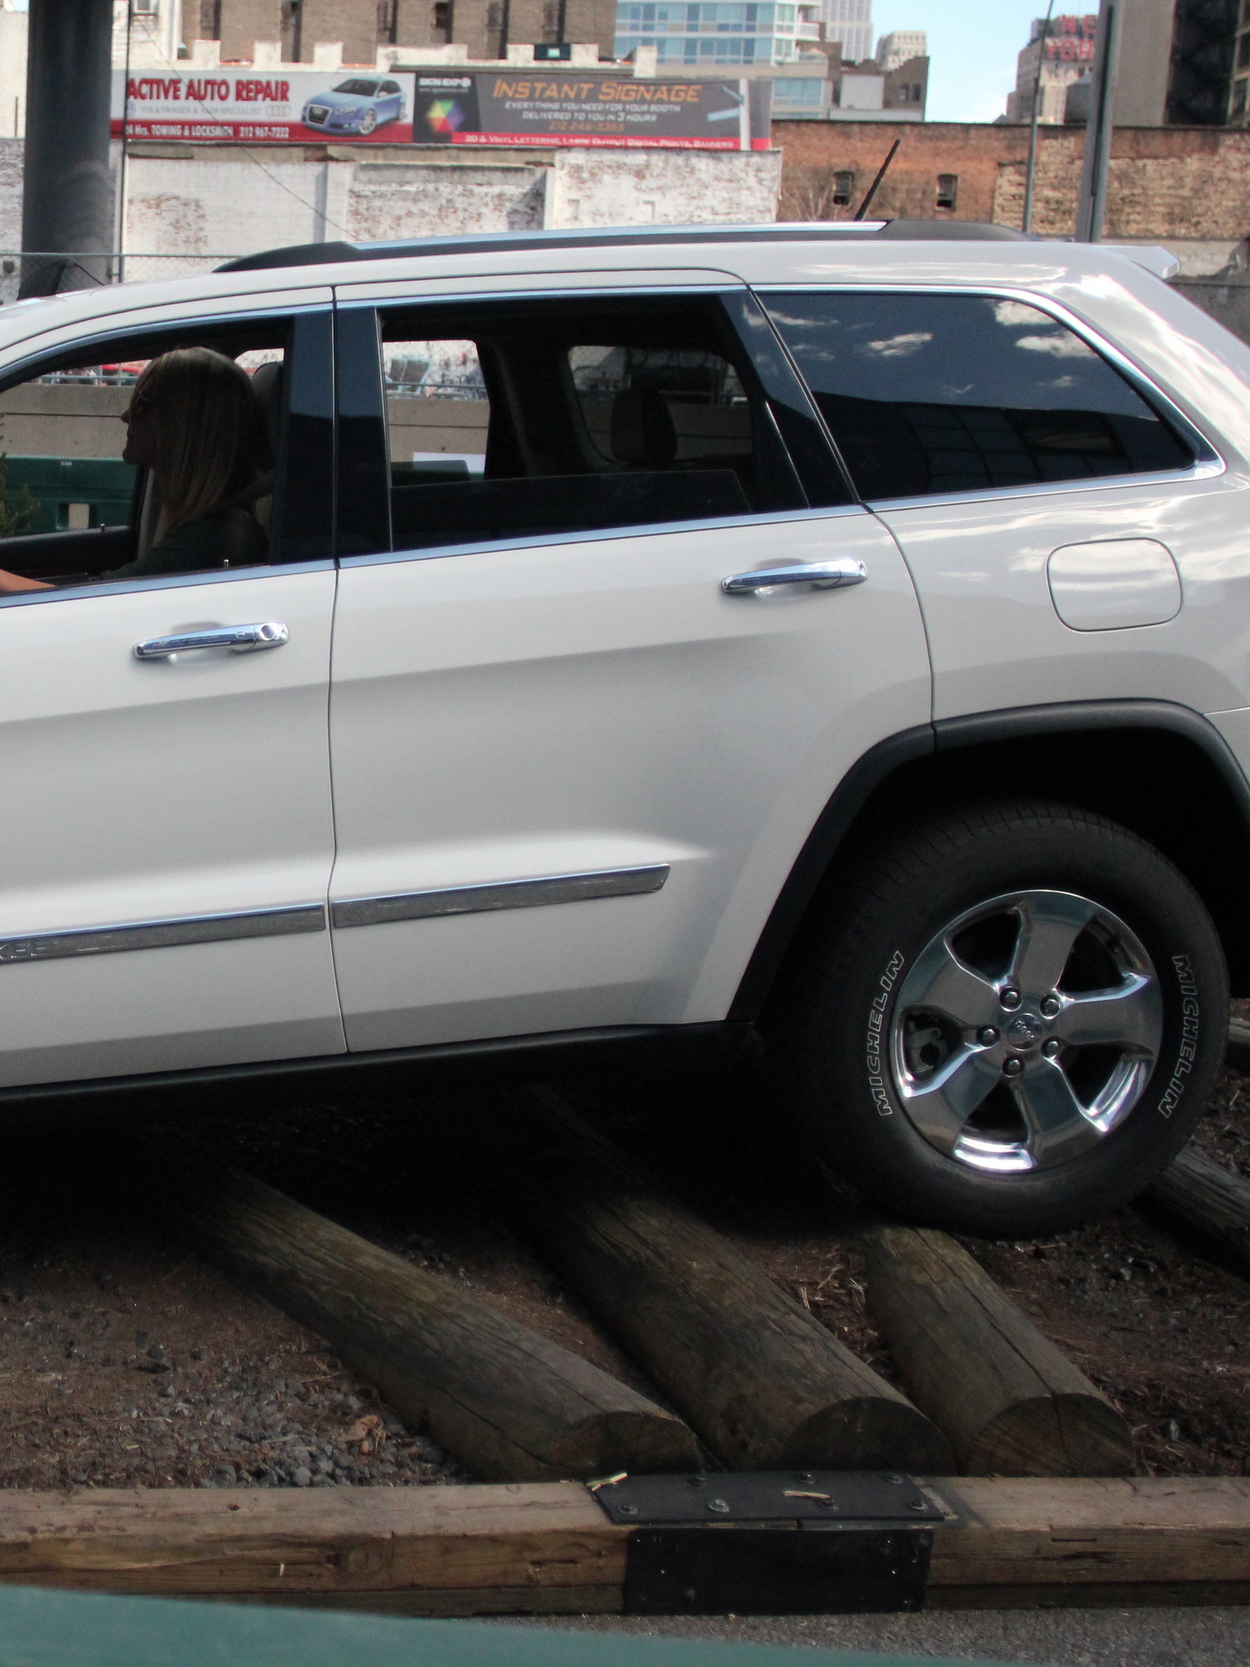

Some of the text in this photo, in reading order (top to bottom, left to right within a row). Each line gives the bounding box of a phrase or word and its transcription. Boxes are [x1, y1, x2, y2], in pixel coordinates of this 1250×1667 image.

[1061, 15, 1097, 34] NE
[1046, 39, 1096, 60] YOR
[127, 78, 290, 102] ACTIVE AUTO REPAIR
[493, 78, 702, 102] INSTANT SIGNAGE
[504, 101, 681, 113] EVERYTHING YOU NEED FOR YOUR BOOTH
[522, 111, 572, 120] DELIVERED
[573, 112, 586, 120] TO
[587, 112, 606, 121] YOU
[626, 113, 657, 122] HOURS
[151, 125, 182, 135] TOWING
[191, 125, 234, 136] LOCKSMITH
[866, 950, 904, 1117] MICHELIN
[1158, 955, 1199, 1119] MICHELIN
